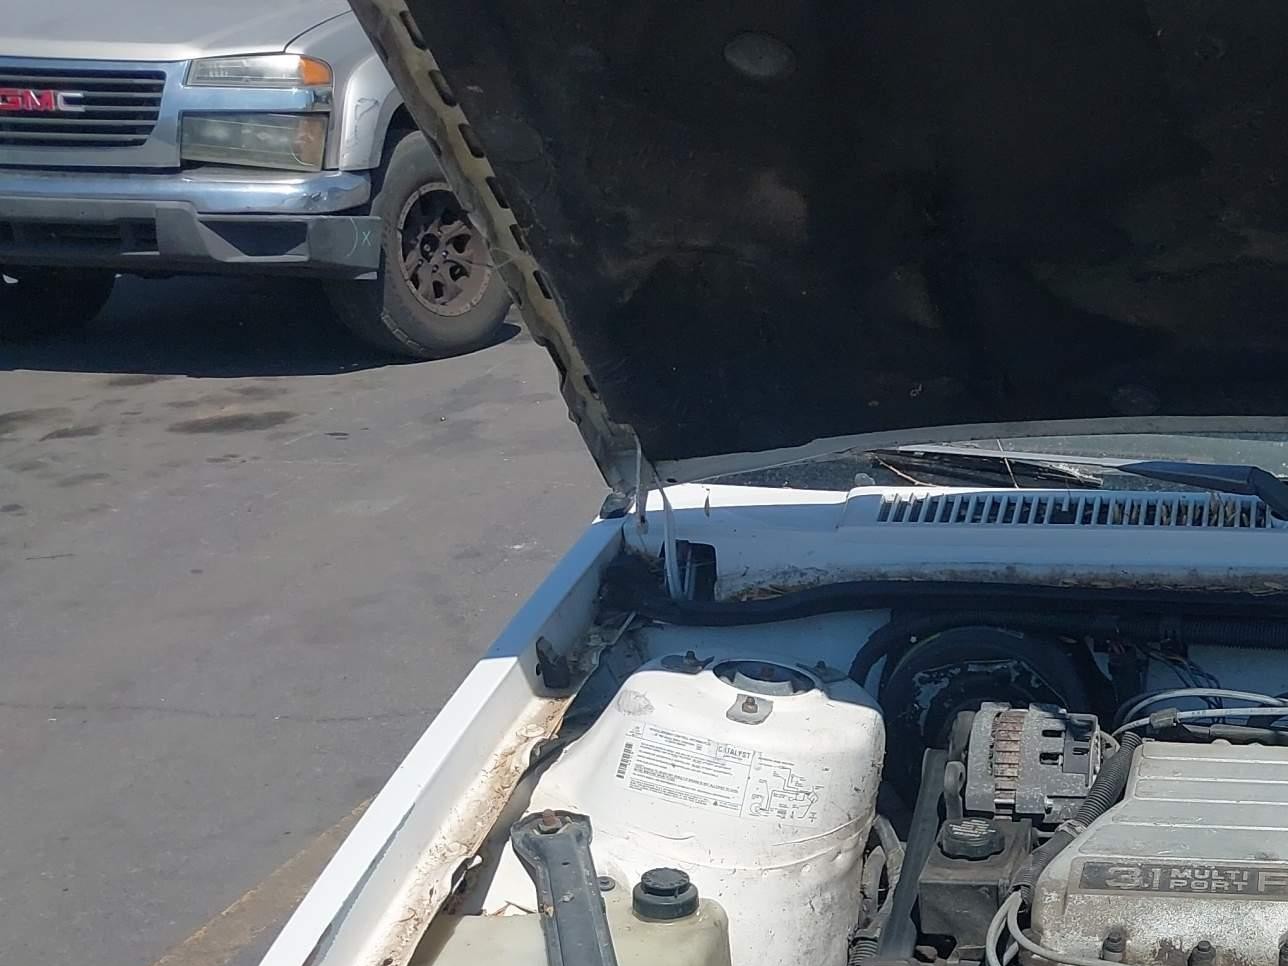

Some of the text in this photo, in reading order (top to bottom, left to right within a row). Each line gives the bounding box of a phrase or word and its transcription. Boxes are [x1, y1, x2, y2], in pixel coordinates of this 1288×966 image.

[0, 87, 86, 112] GMC
[1169, 867, 1249, 881] MULTI
[1169, 879, 1249, 892] PORT
